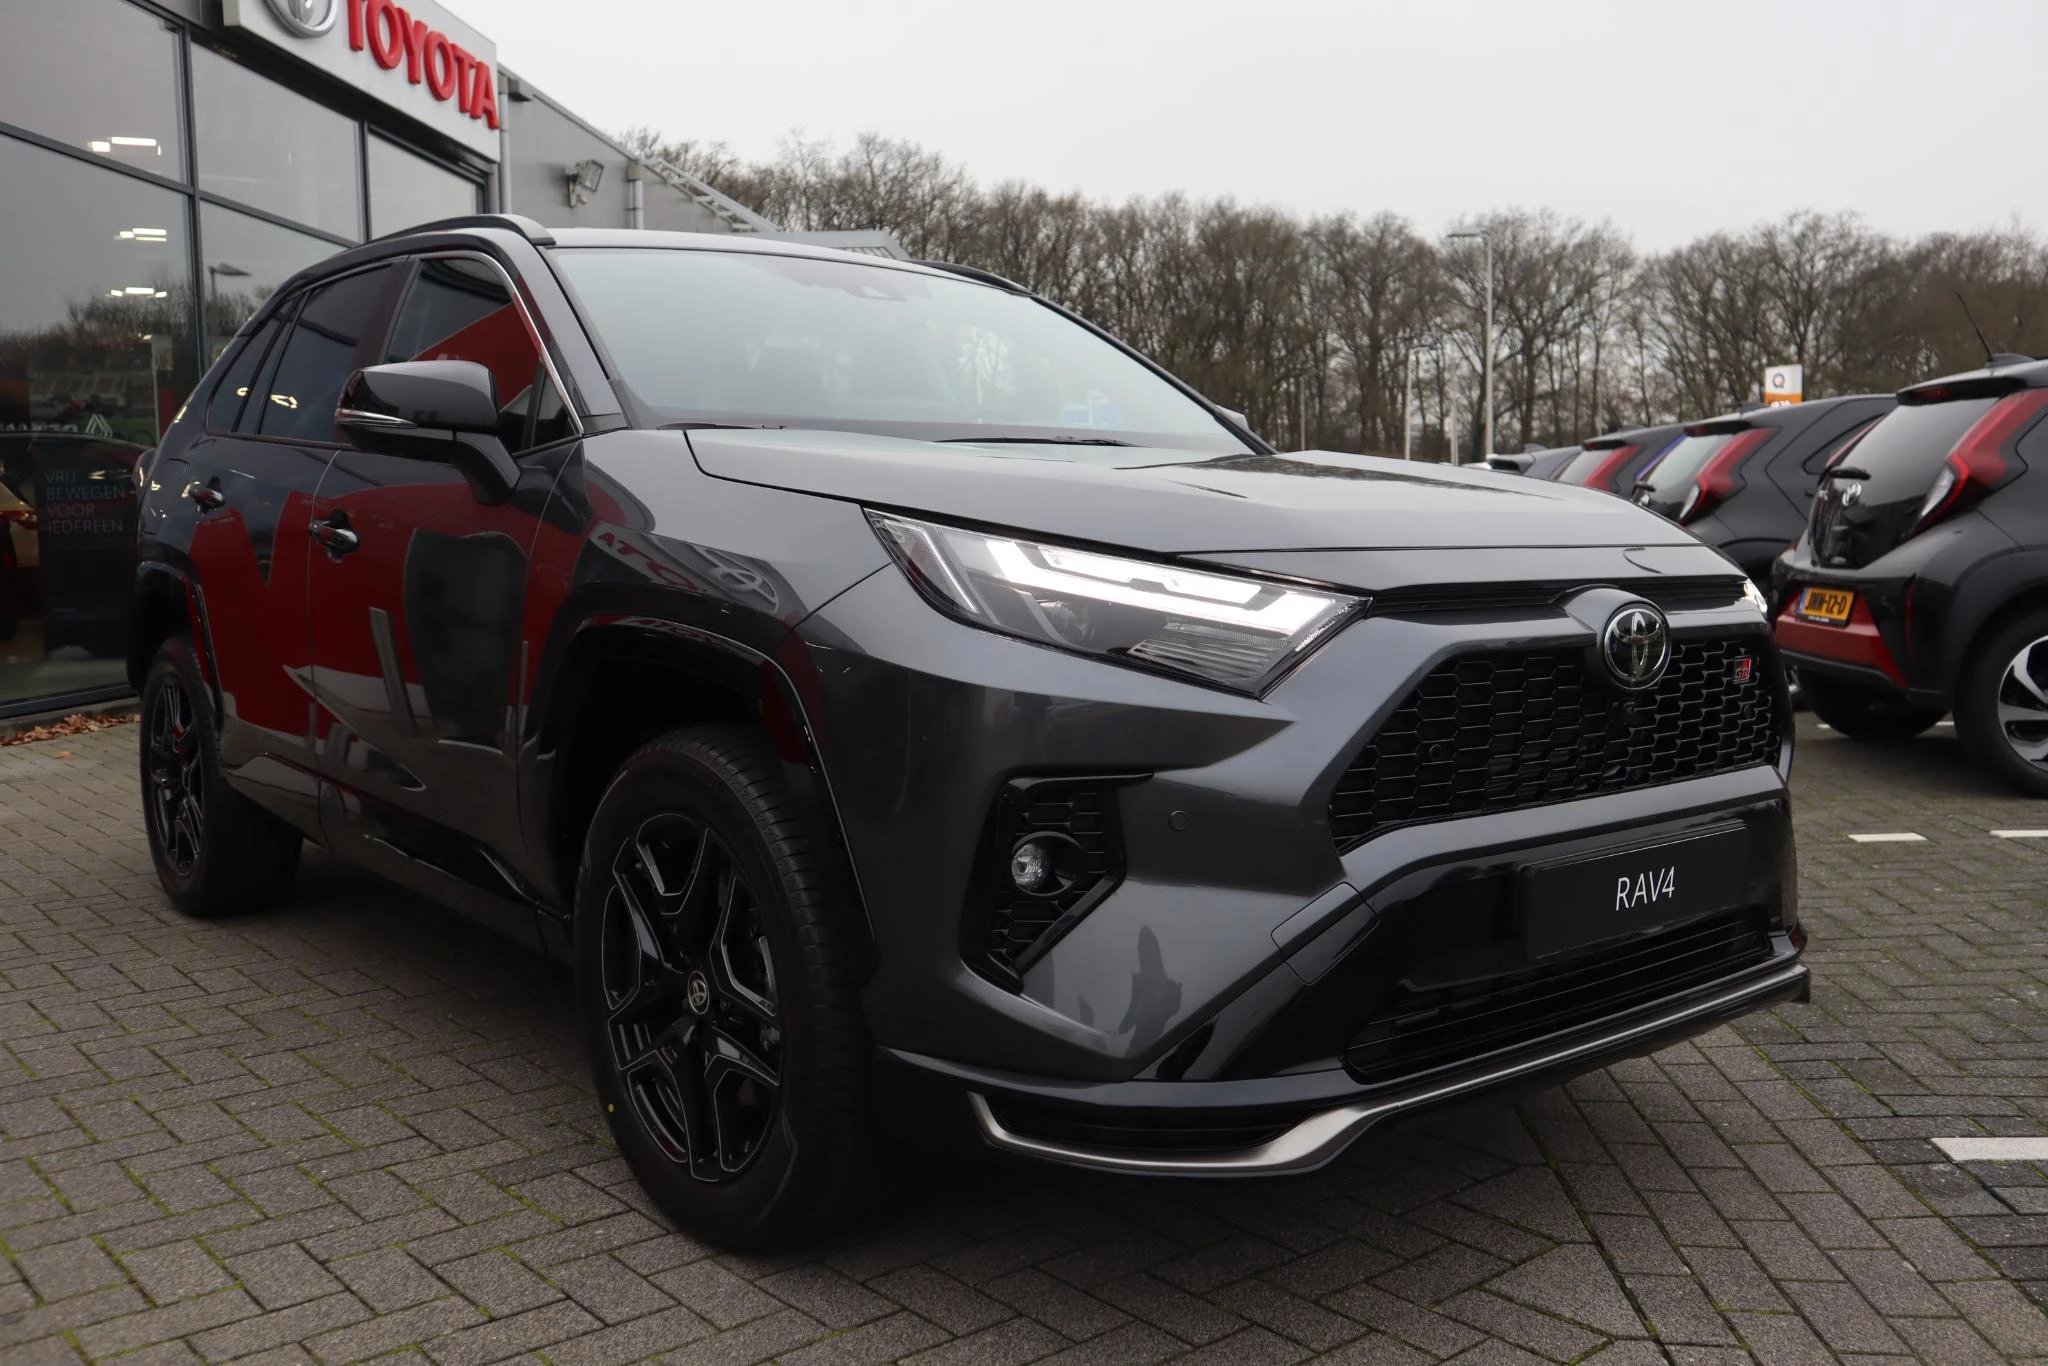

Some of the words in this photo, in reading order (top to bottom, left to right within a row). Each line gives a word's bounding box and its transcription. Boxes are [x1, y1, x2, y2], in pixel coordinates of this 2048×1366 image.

[347, 0, 499, 129] TOYOTA
[45, 470, 76, 484] VRIJ
[46, 485, 125, 501] BEWEGEN
[46, 503, 96, 518] VOOR
[48, 518, 124, 535] IEDEREEN
[1615, 865, 1675, 911] RAV4
